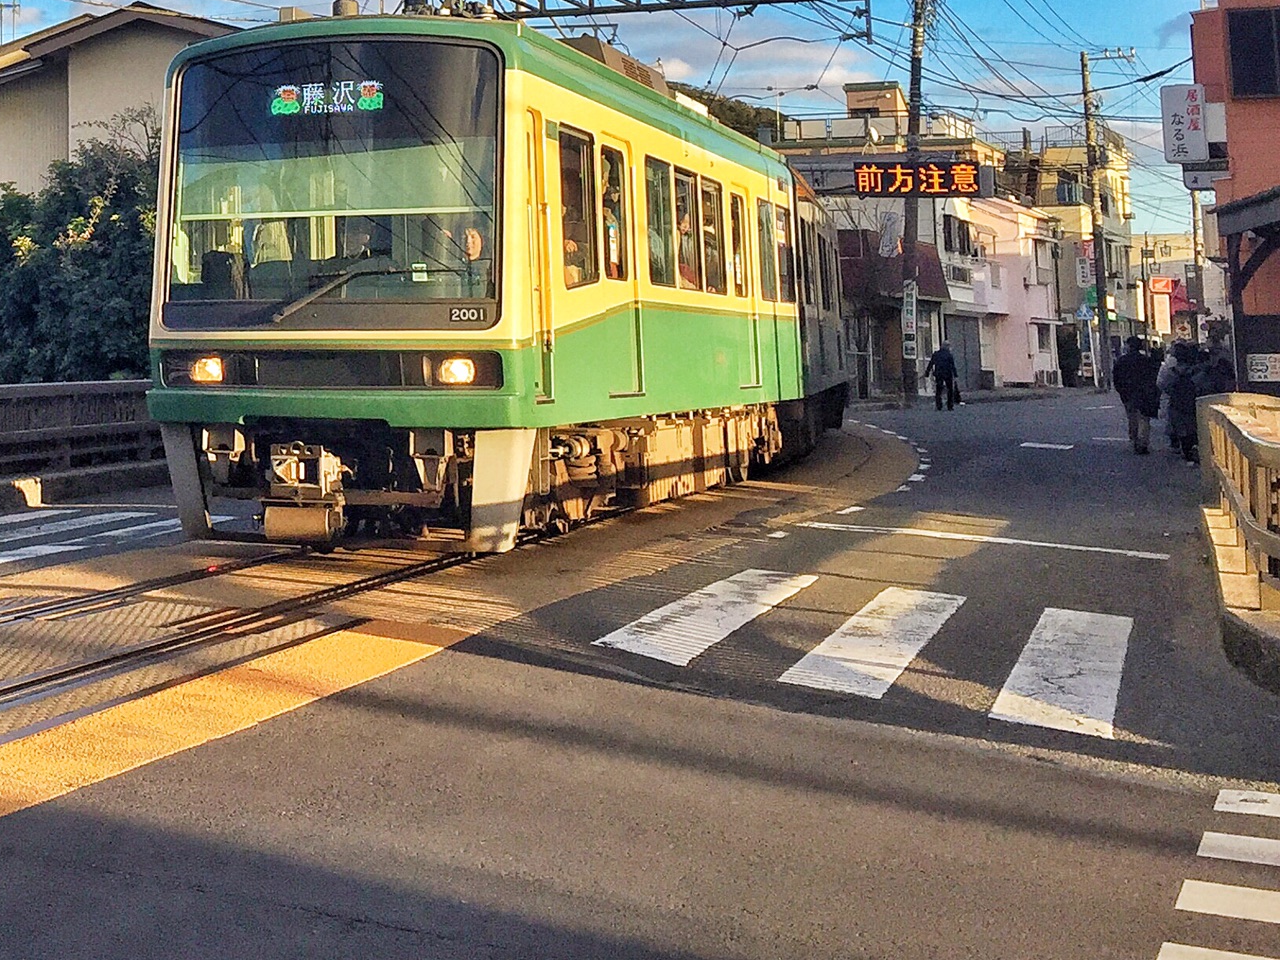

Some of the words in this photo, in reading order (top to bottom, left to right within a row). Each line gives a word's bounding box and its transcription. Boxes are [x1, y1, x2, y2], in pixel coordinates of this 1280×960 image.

[301, 80, 355, 107] 藤沢
[304, 103, 354, 114] FUJISAWA
[1185, 89, 1201, 131] 居酒屋
[1171, 112, 1189, 157] なる浜
[855, 164, 978, 193] 前方注意
[451, 309, 484, 320] 2001
